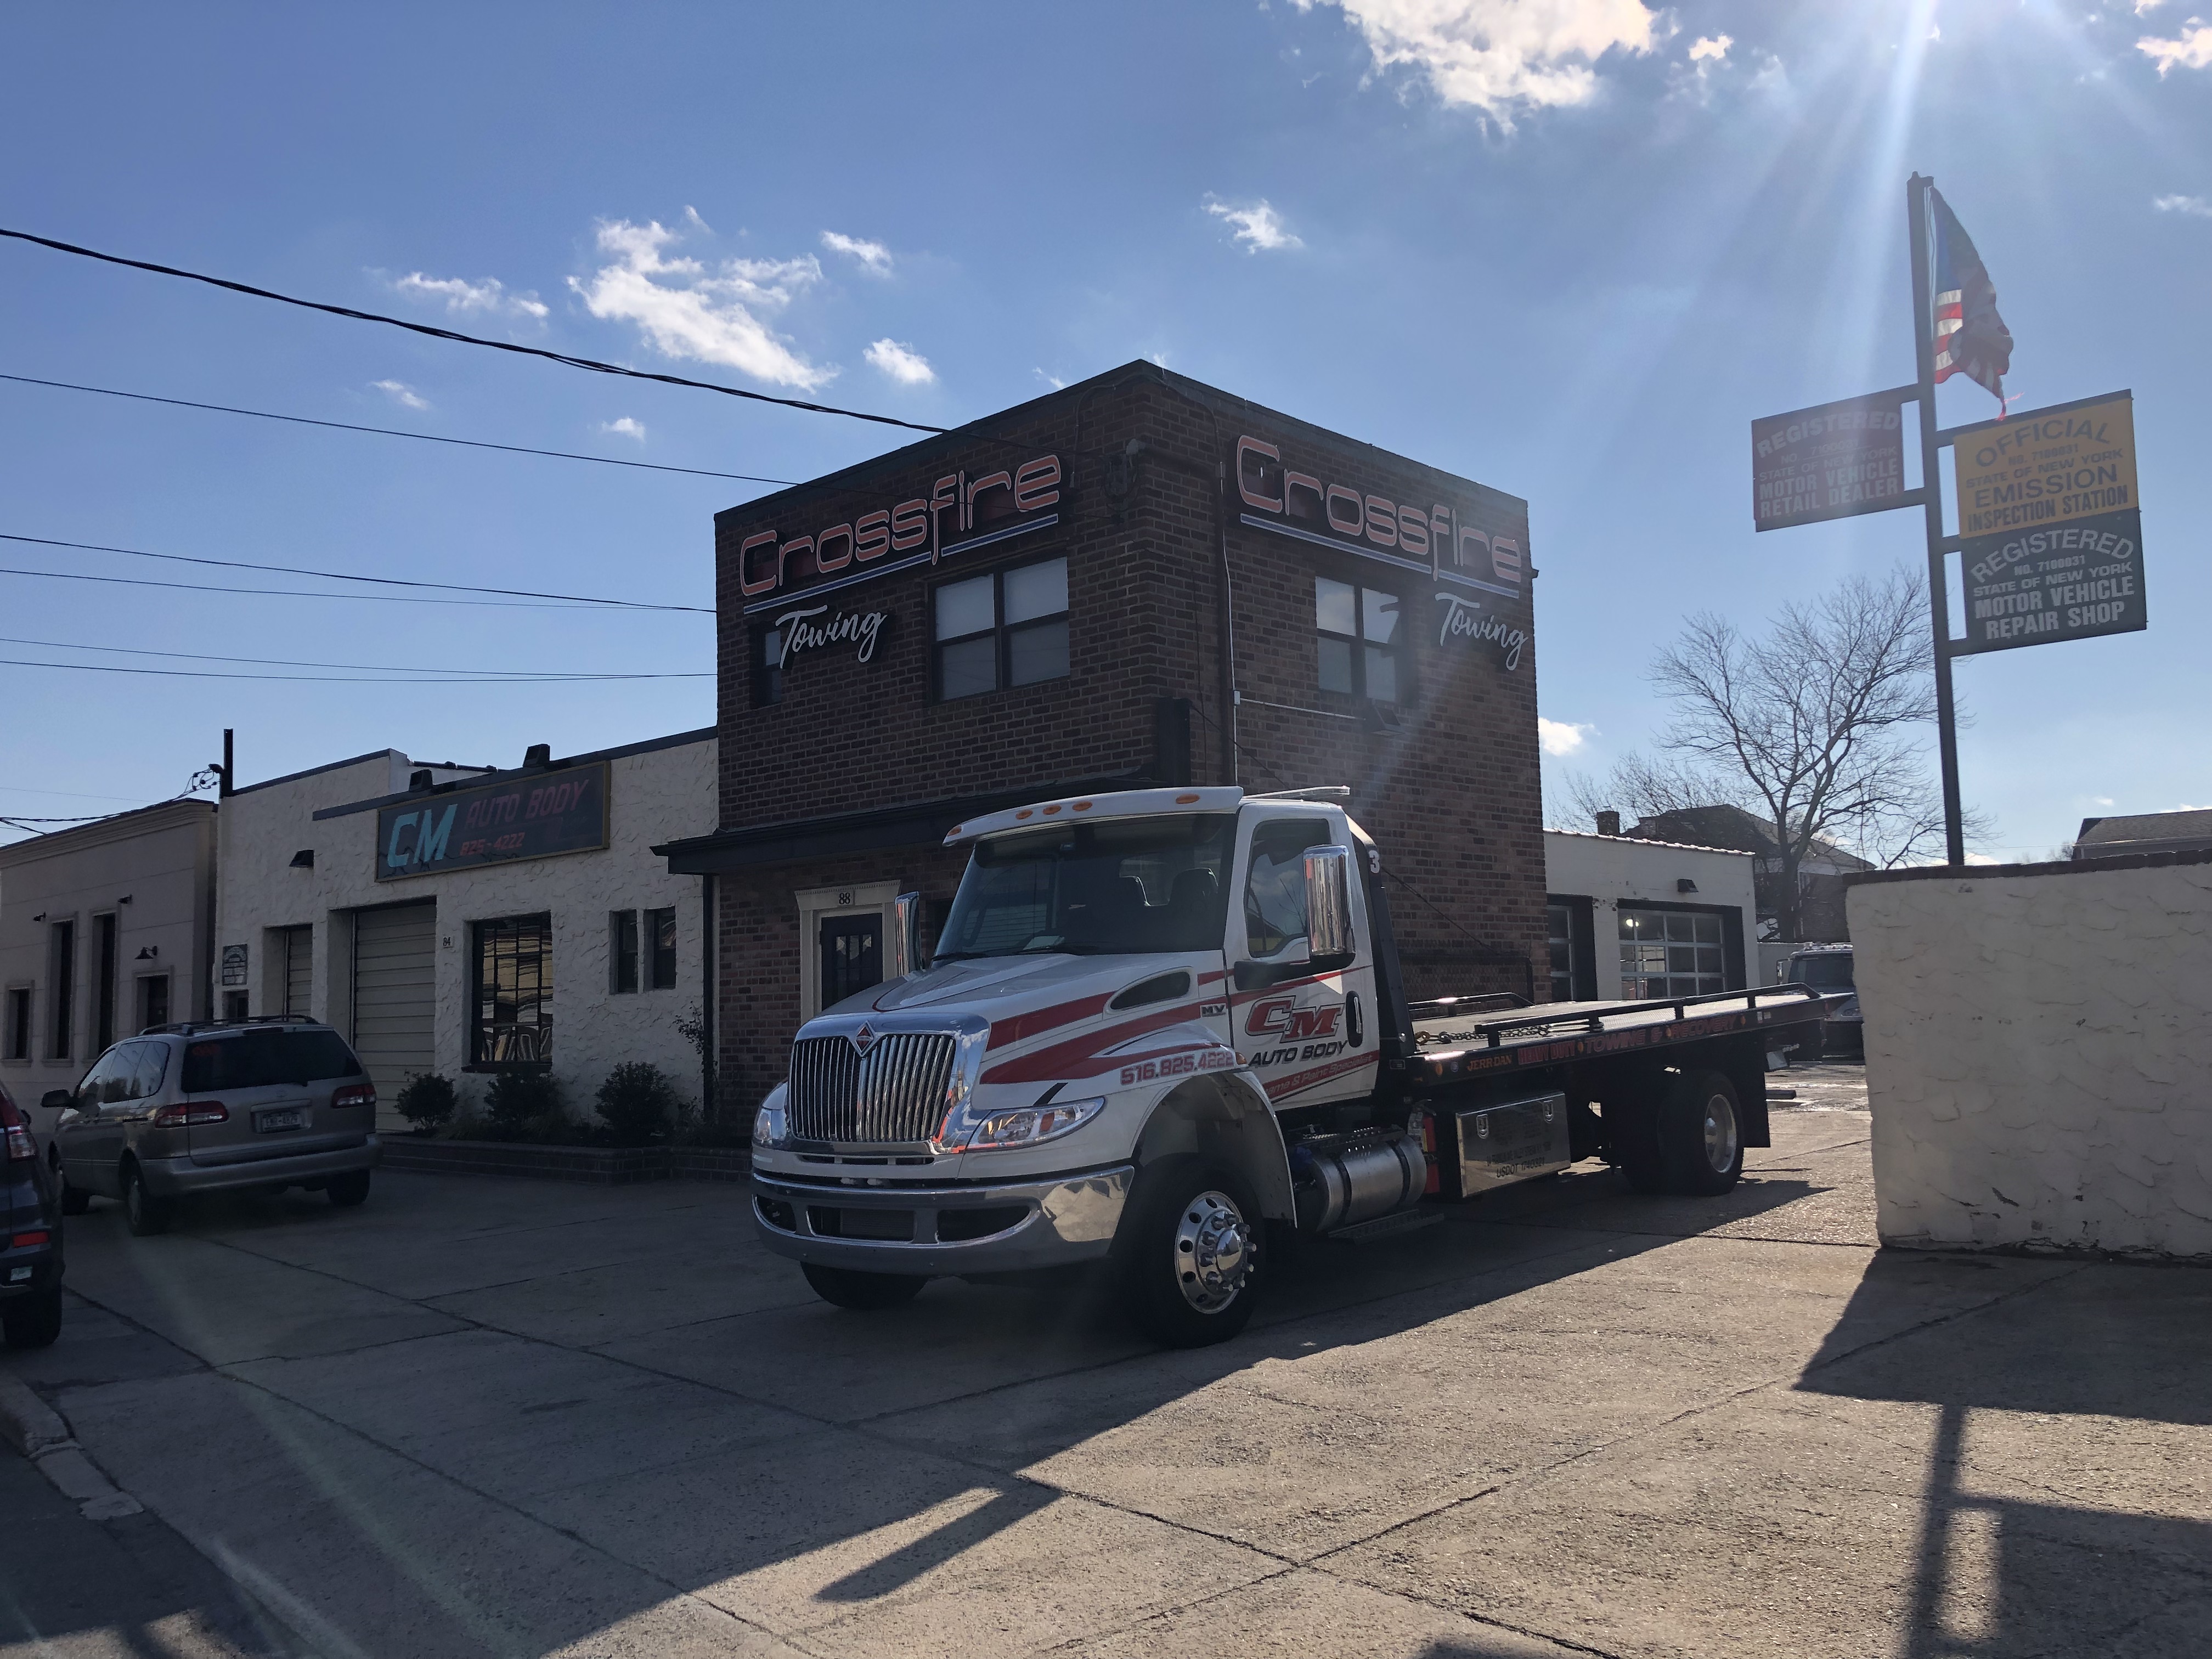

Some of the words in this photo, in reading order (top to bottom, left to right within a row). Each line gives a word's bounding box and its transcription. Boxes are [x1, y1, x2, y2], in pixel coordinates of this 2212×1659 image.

[1757, 411, 1900, 458] REGISTERED
[1976, 419, 2110, 467] OFFICIAL
[1759, 466, 1795, 481] STATE
[1801, 461, 1818, 473] OF
[1824, 454, 1854, 469] NEW
[1861, 446, 1897, 461] YORK
[1759, 474, 1818, 500] MOTOR
[1826, 458, 1898, 487] VEHICLE
[1966, 471, 2007, 488] STATE
[2013, 466, 2032, 478] OF
[2038, 458, 2074, 474] NEW
[2081, 448, 2123, 465] YORK
[1760, 492, 1820, 518] RETAIL
[1829, 477, 1898, 506] DEALER
[1976, 464, 2118, 508] EMISSION
[740, 454, 1062, 596] Crossfire
[1237, 435, 1521, 583] Crossfire
[1968, 499, 2056, 532] INSPECTION
[2062, 484, 2128, 515] STATION
[1971, 529, 2134, 583] REGISTERED
[2037, 555, 2085, 571] 7100031
[1974, 581, 2016, 597] STATE
[2021, 577, 2040, 589] OF
[2046, 570, 2084, 585] NEW
[2089, 561, 2133, 578] YORK
[1975, 590, 2043, 619] MOTOR
[2050, 575, 2135, 607] VEHICLE
[775, 604, 888, 669] Towing
[1435, 591, 1528, 671] Towing
[1985, 611, 2059, 640] REPAIR
[2067, 601, 2125, 627] SHOP
[387, 804, 458, 867] CM
[464, 793, 520, 828] AUTO
[525, 779, 589, 820] BODY
[461, 832, 525, 856] 825-4222
[1368, 850, 1380, 873] 3
[839, 892, 850, 905] 88
[1202, 1005, 1226, 1015] MV
[1244, 995, 1346, 1044] CM
[1249, 1047, 1299, 1067] AUTO
[1300, 1040, 1348, 1062] BODY
[1517, 1044, 1549, 1065] HEAVY
[1550, 1040, 1575, 1059] DUTY
[1585, 1029, 1646, 1053] TOWING
[1670, 1015, 1737, 1039] RECOVERY
[1120, 1051, 1234, 1085] 516.825.4222
[1267, 1081, 1289, 1094] ame
[1291, 1075, 1300, 1086] &
[1301, 1068, 1329, 1083] Paint
[1329, 1054, 1373, 1074] Specialist
[1497, 1163, 1519, 1178] USDOT
